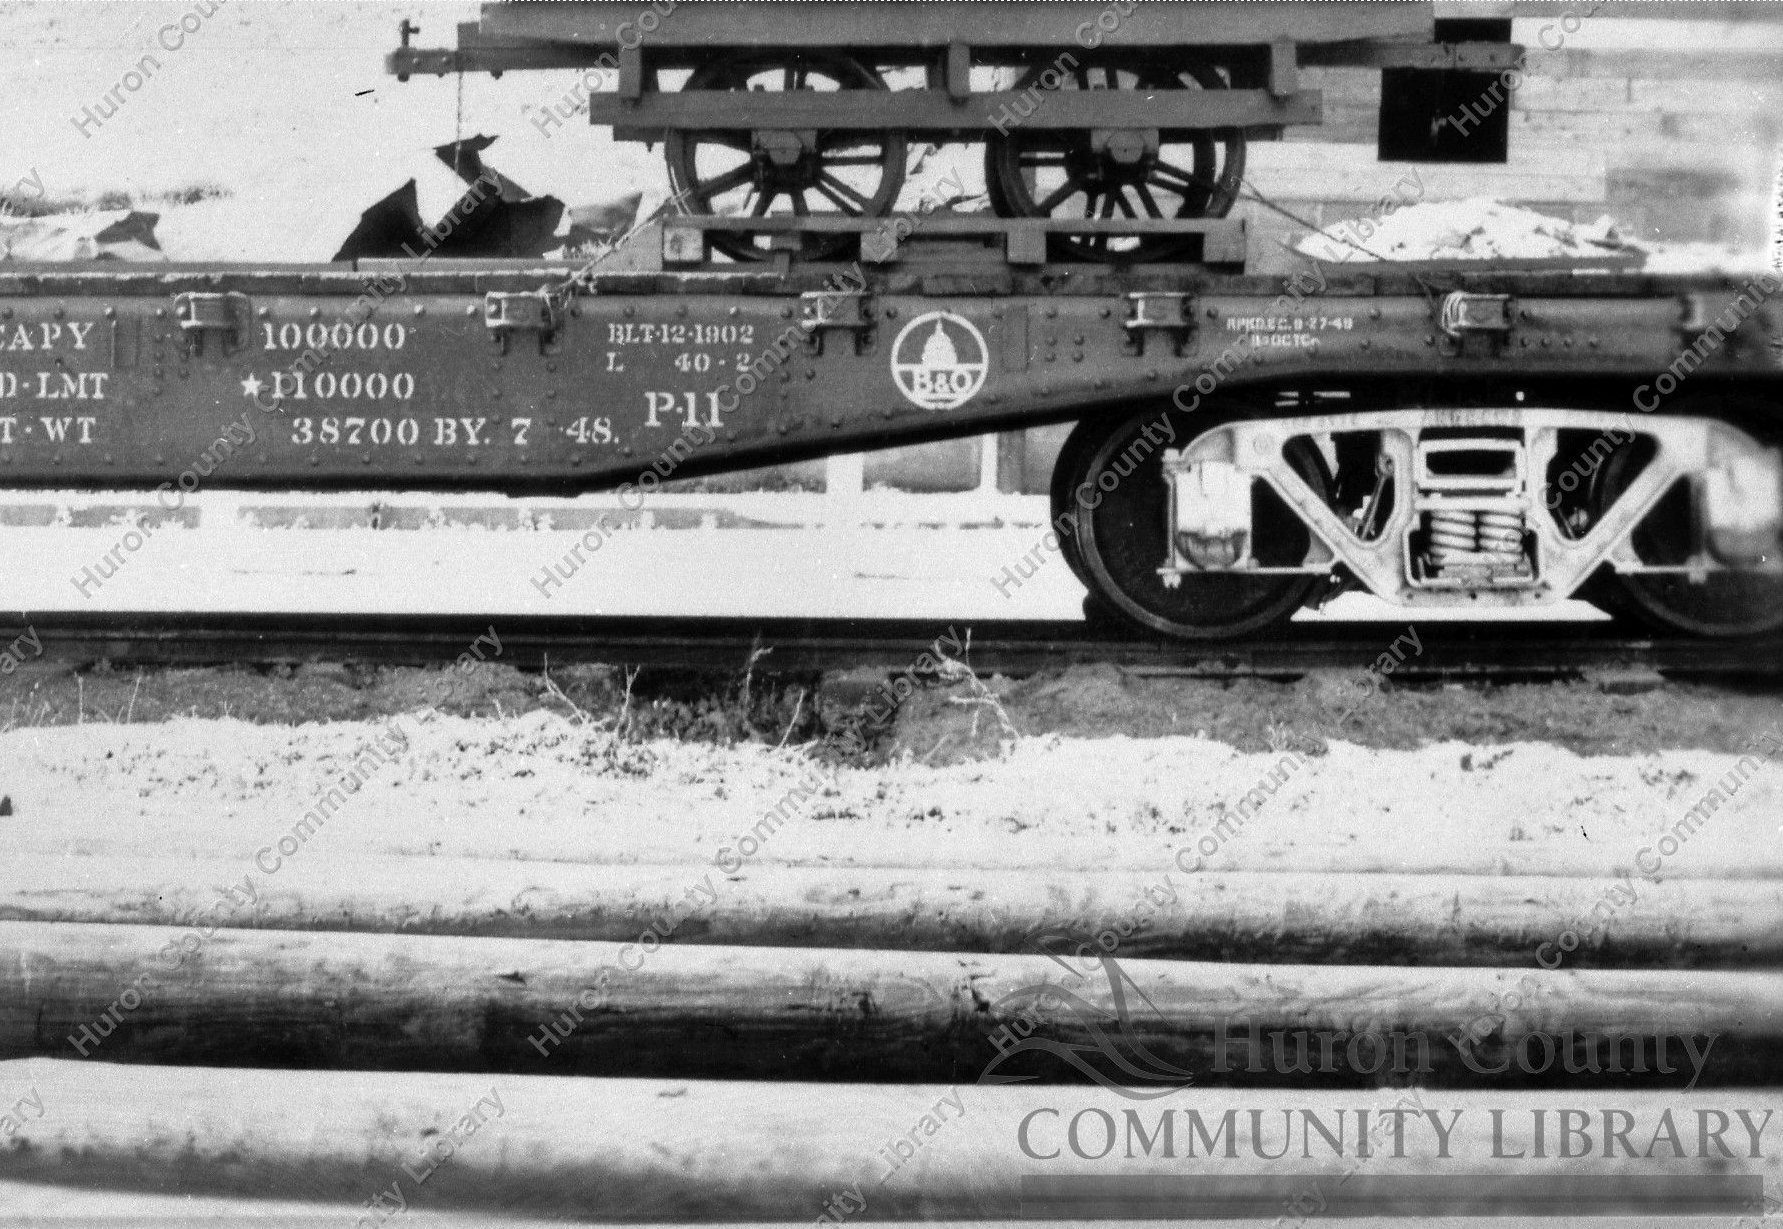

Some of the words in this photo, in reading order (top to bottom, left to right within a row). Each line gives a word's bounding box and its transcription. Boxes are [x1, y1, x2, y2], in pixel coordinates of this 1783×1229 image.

[263, 322, 406, 350] 100000
[606, 352, 624, 373] L
[913, 369, 973, 394] B&O
[291, 416, 419, 445] 38700
[510, 416, 532, 445] 7
